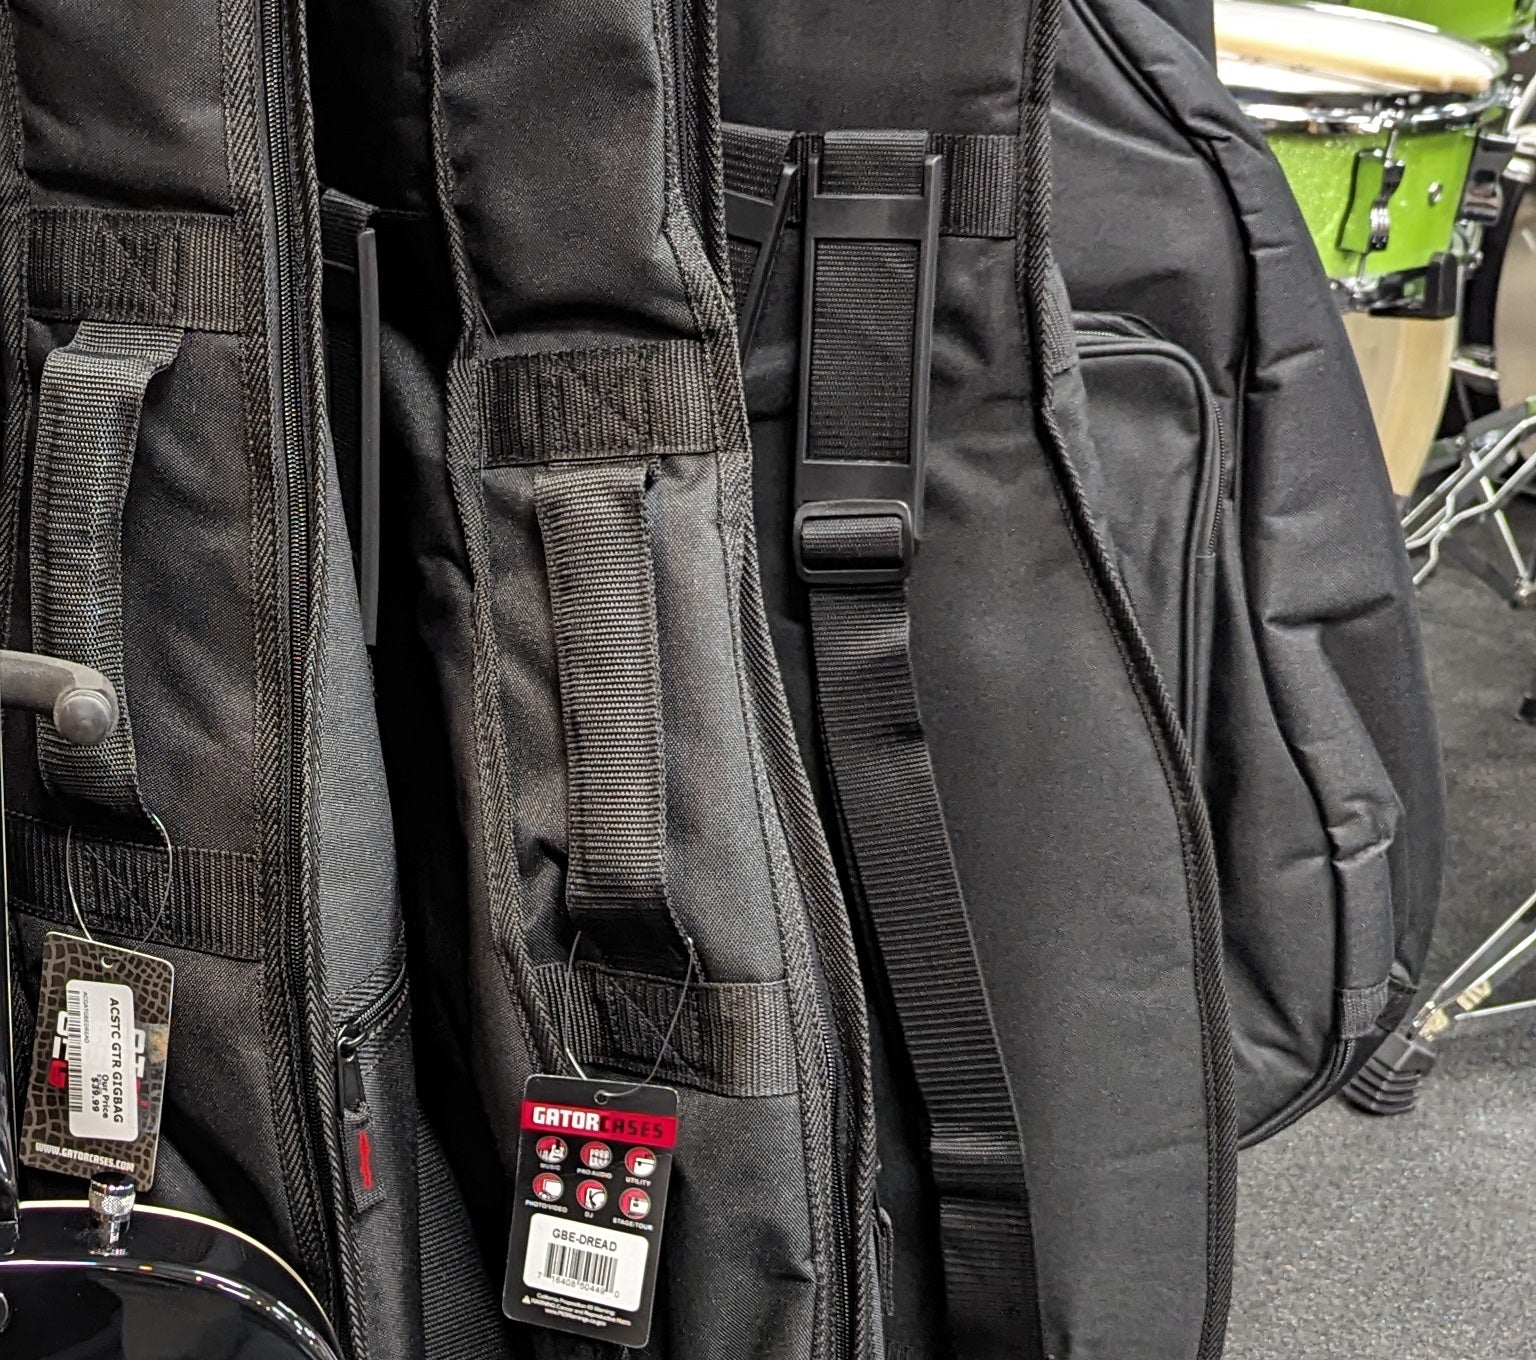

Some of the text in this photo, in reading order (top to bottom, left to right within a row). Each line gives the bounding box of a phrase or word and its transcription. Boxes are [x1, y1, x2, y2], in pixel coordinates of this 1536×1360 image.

[109, 997, 123, 1123] ACSTC GTR GIGBAG
[91, 1077, 100, 1113] $39.99
[101, 1074, 110, 1119] Our Price
[532, 1106, 664, 1139] GATORCASES
[552, 1228, 617, 1252] GBE-DREAD
